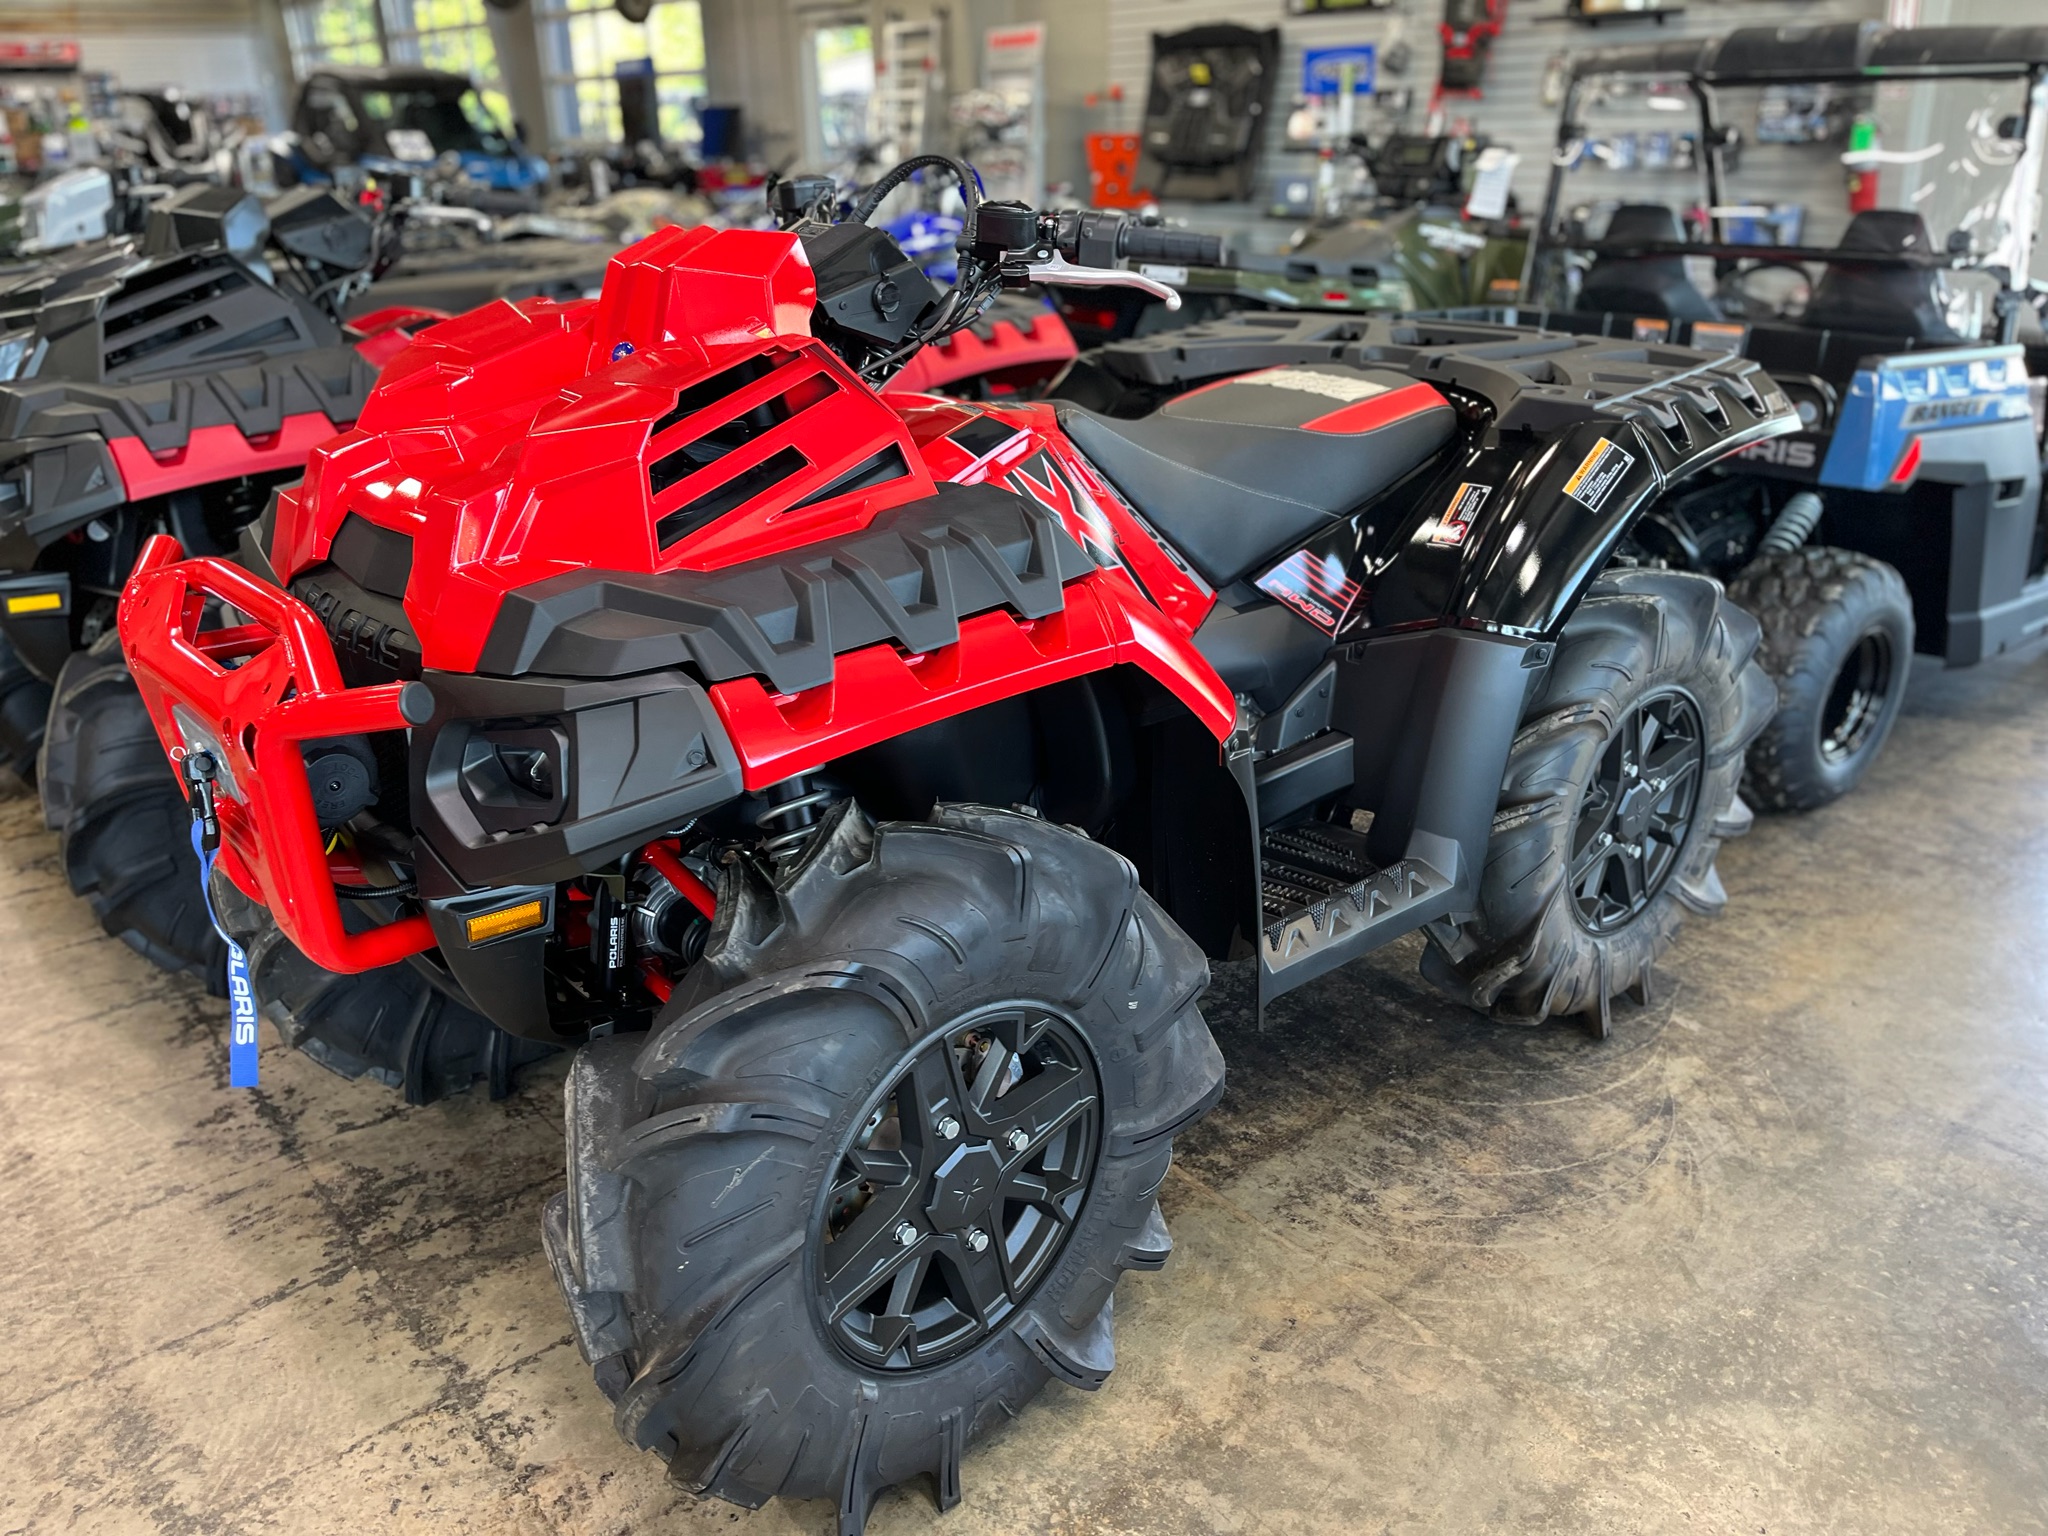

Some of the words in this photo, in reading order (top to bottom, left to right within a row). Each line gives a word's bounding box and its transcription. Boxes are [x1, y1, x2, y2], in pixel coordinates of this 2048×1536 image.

[1579, 451, 1599, 475] WARNING
[305, 582, 410, 671] POLARIS
[1267, 579, 1336, 627] AWD
[609, 917, 619, 969] POLARIS
[229, 943, 255, 1046] OLARIS
